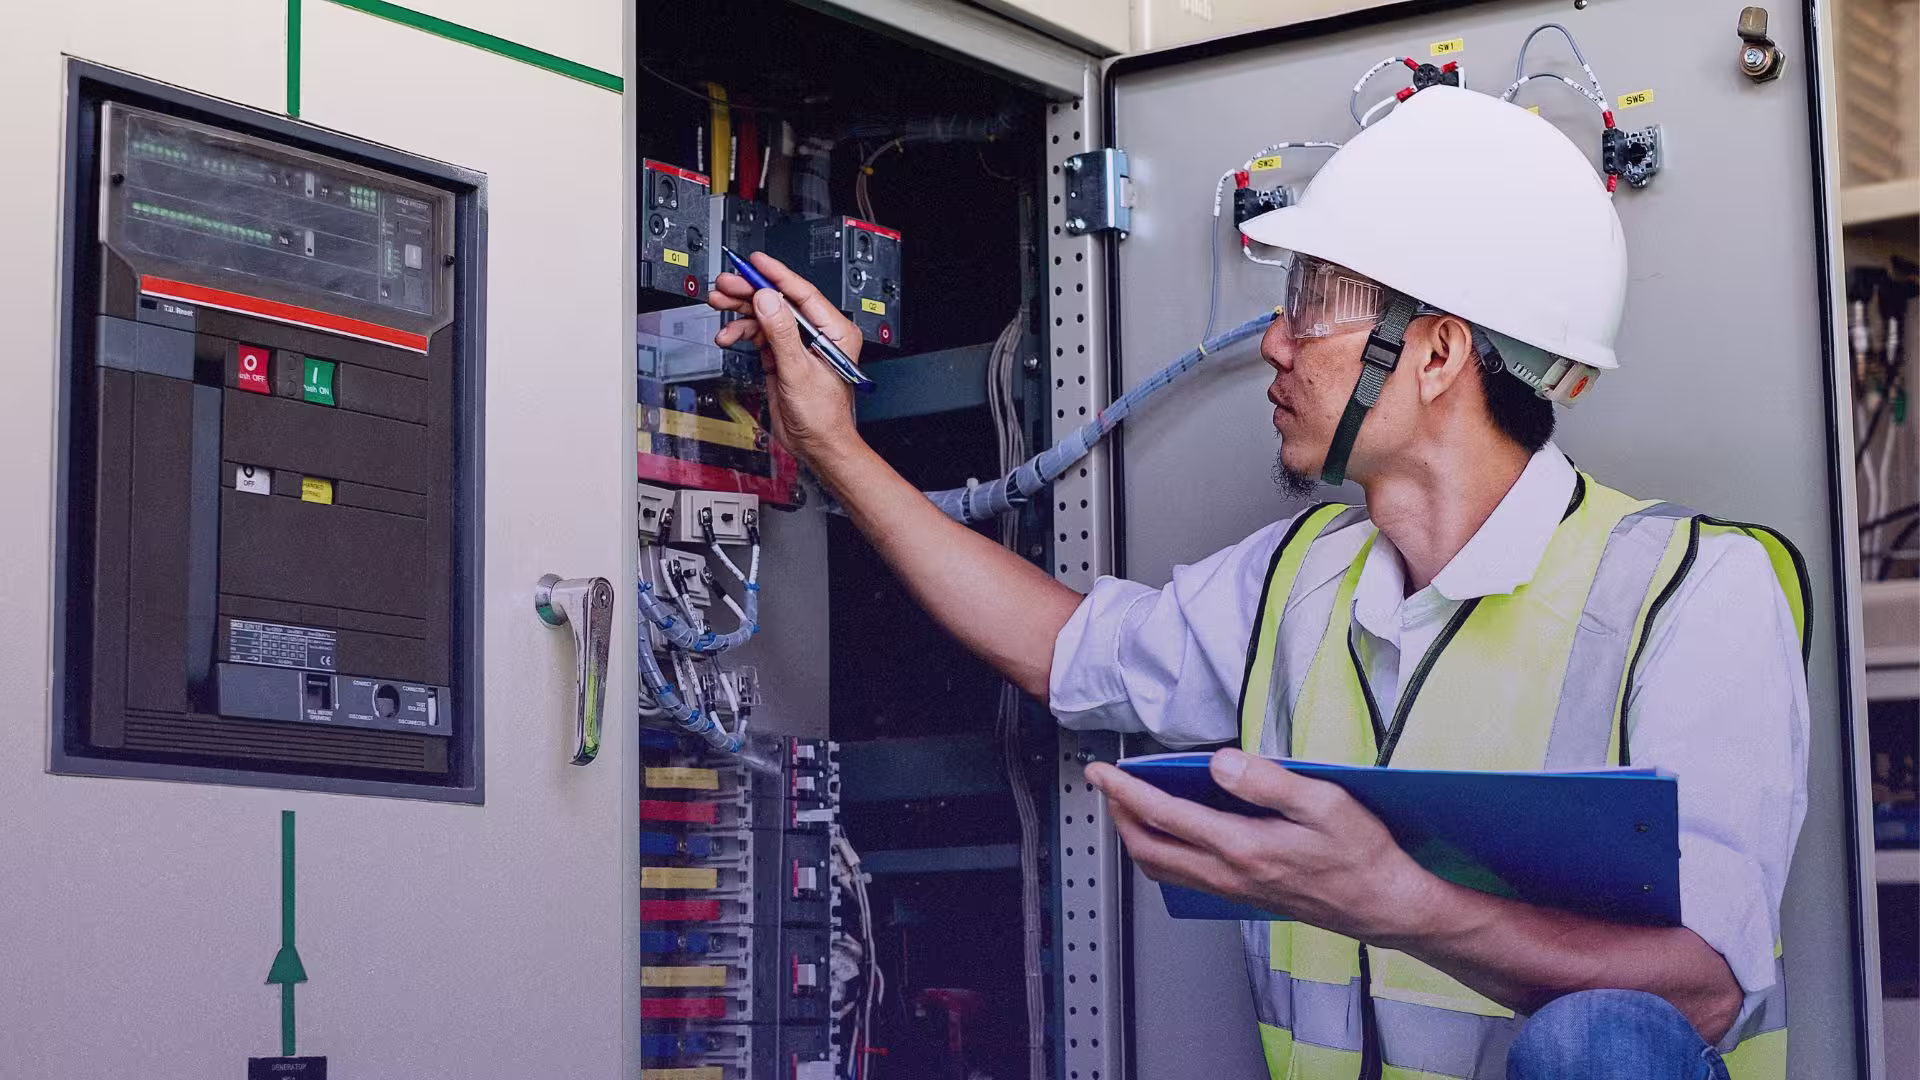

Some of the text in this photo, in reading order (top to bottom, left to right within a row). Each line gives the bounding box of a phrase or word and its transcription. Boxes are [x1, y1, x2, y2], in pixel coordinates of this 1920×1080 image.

[1438, 43, 1454, 52] SW1
[1626, 93, 1645, 104] SW5
[1258, 159, 1274, 168] SW2
[671, 252, 680, 263] Q1
[869, 302, 877, 311] Q2
[252, 374, 266, 383] OFF
[319, 387, 330, 395] ON
[271, 1063, 307, 1071] GENERATOR
